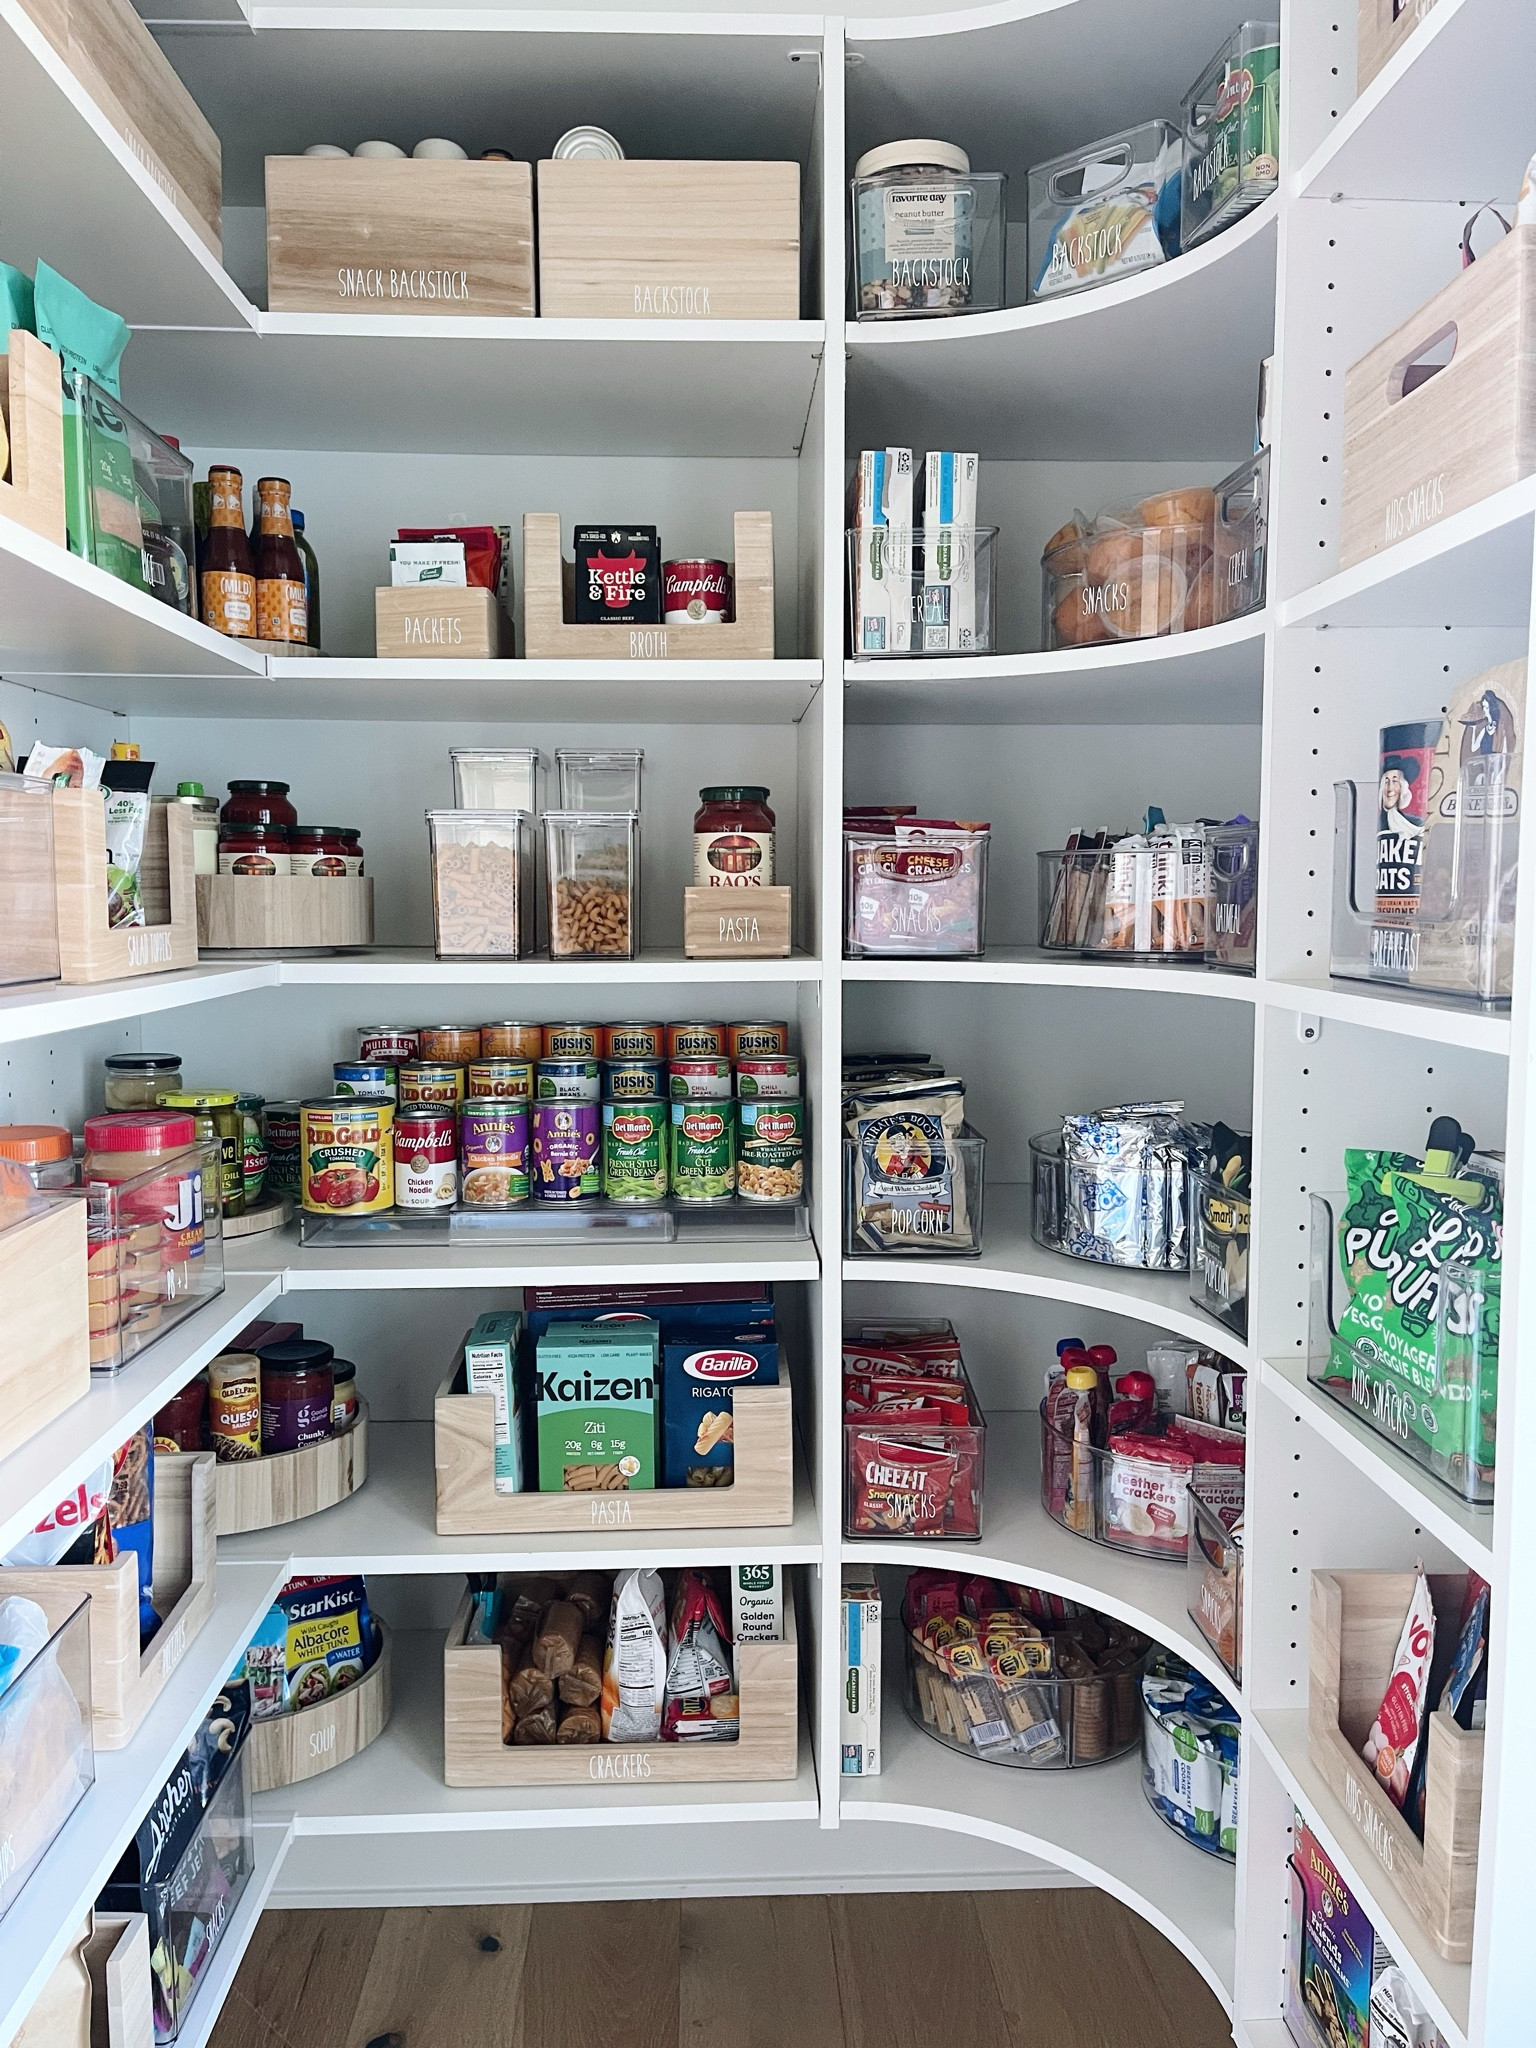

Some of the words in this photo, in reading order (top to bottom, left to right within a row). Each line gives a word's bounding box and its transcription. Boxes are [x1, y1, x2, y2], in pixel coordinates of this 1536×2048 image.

[1193, 133, 1229, 202] BACKSTOCK
[1052, 223, 1122, 274] BACKSTOCK
[892, 257, 970, 287] BACKSTOCK
[338, 268, 384, 298] SNACK
[390, 270, 469, 300] BACKSTOCK
[634, 286, 711, 315] BACKSTOCK
[1385, 496, 1404, 543] KIDS
[1407, 472, 1444, 531] SNACKS
[1227, 548, 1249, 587] CEREAL
[587, 568, 646, 585] Kettle
[588, 584, 603, 601] &
[605, 585, 646, 601] Fire
[1082, 582, 1128, 615] SNACKS
[901, 594, 950, 624] CEREAL
[404, 616, 462, 645] PACKETS
[629, 631, 668, 658] BROTH
[109, 807, 127, 815] Less
[907, 855, 950, 867] CHEESE
[1158, 840, 1172, 897] think!
[709, 874, 762, 887] RAO'S
[891, 907, 942, 932] SNACKS
[1215, 903, 1242, 935] OATMEAL
[719, 917, 761, 943] PASTA
[127, 934, 149, 967] SALAD
[1372, 929, 1422, 972] BREAKFAST
[365, 1040, 388, 1051] MUIR
[391, 1040, 414, 1050] GLEN
[552, 1037, 592, 1051] BUSH'S
[613, 1037, 653, 1051] BUSH'S
[677, 1035, 717, 1050] BUSH'S
[738, 1034, 778, 1049] BUSH'S
[613, 1075, 654, 1090] BUSH'S
[472, 1120, 516, 1136] Annie's
[615, 1123, 627, 1132] Del
[626, 1123, 651, 1132] Monte
[685, 1121, 698, 1130] Del
[697, 1121, 721, 1130] Monte
[759, 1121, 772, 1130] Del
[771, 1121, 794, 1130] Monte
[863, 1114, 906, 1146] PIRATE'S
[394, 1126, 452, 1152] Campbell's
[546, 1130, 581, 1139] Annie's
[318, 1147, 366, 1159] CRUSHED
[469, 1155, 496, 1163] Chicken
[496, 1154, 519, 1162] Noodle
[741, 1149, 792, 1158] FIRE-ROASTED
[609, 1159, 636, 1169] FRENCH
[636, 1158, 658, 1168] STYLE
[680, 1165, 704, 1175] GREEN
[704, 1166, 728, 1175] BEANS
[695, 1158, 712, 1167] CUT
[224, 1171, 240, 1181] DILL
[609, 1167, 633, 1177] GREEN
[633, 1167, 657, 1178] BEANS
[407, 1178, 433, 1186] Chicken
[408, 1186, 433, 1194] Noodle
[878, 1184, 894, 1193] Aged
[894, 1184, 913, 1192] White
[913, 1184, 938, 1192] Cheddar
[892, 1209, 944, 1235] POPCORN
[1383, 1327, 1436, 1371] VOYAGER
[701, 1356, 753, 1374] Barilla
[221, 1389, 235, 1398] OLD
[536, 1369, 654, 1402] Kaizen
[1351, 1364, 1371, 1410] KIDS
[1372, 1380, 1409, 1441] SNACKS
[220, 1408, 259, 1425] QUESO
[231, 1421, 251, 1429] SAUCE
[297, 1429, 326, 1441] Chunky
[584, 1421, 606, 1434] Ziti
[564, 1440, 582, 1451] 20g
[590, 1440, 603, 1451] 6g
[610, 1439, 626, 1450] 15g
[1117, 1474, 1165, 1492] teether
[1123, 1486, 1176, 1505] crackers
[591, 1500, 632, 1525] PASTA
[863, 1501, 883, 1509] CLASSIC
[886, 1493, 936, 1519] SNACKS
[742, 1565, 770, 1581] 365
[287, 1580, 308, 1593] TUNA
[289, 1592, 355, 1621] StarKist
[739, 1597, 774, 1609] Organic
[740, 1612, 775, 1621] Golden
[300, 1626, 317, 1636] Wild
[317, 1619, 340, 1632] Caught
[742, 1622, 773, 1631] Round
[293, 1625, 350, 1652] Albacore
[736, 1633, 779, 1641] Crackers
[297, 1643, 325, 1659] WHITE
[327, 1636, 349, 1650] TUNA
[335, 1647, 361, 1660] WATER
[1391, 1696, 1404, 1718] GLUTEN
[309, 1724, 336, 1758] SOUP
[590, 1753, 651, 1780] CRACKERS
[1345, 1770, 1363, 1821] KIDS
[1363, 1798, 1394, 1871] SNACKS
[1309, 1847, 1350, 1916] Annie's
[1317, 1910, 1338, 1940] Organic
[1311, 1910, 1344, 1965] Friends
[1321, 1945, 1350, 1989] GRAHAMS
